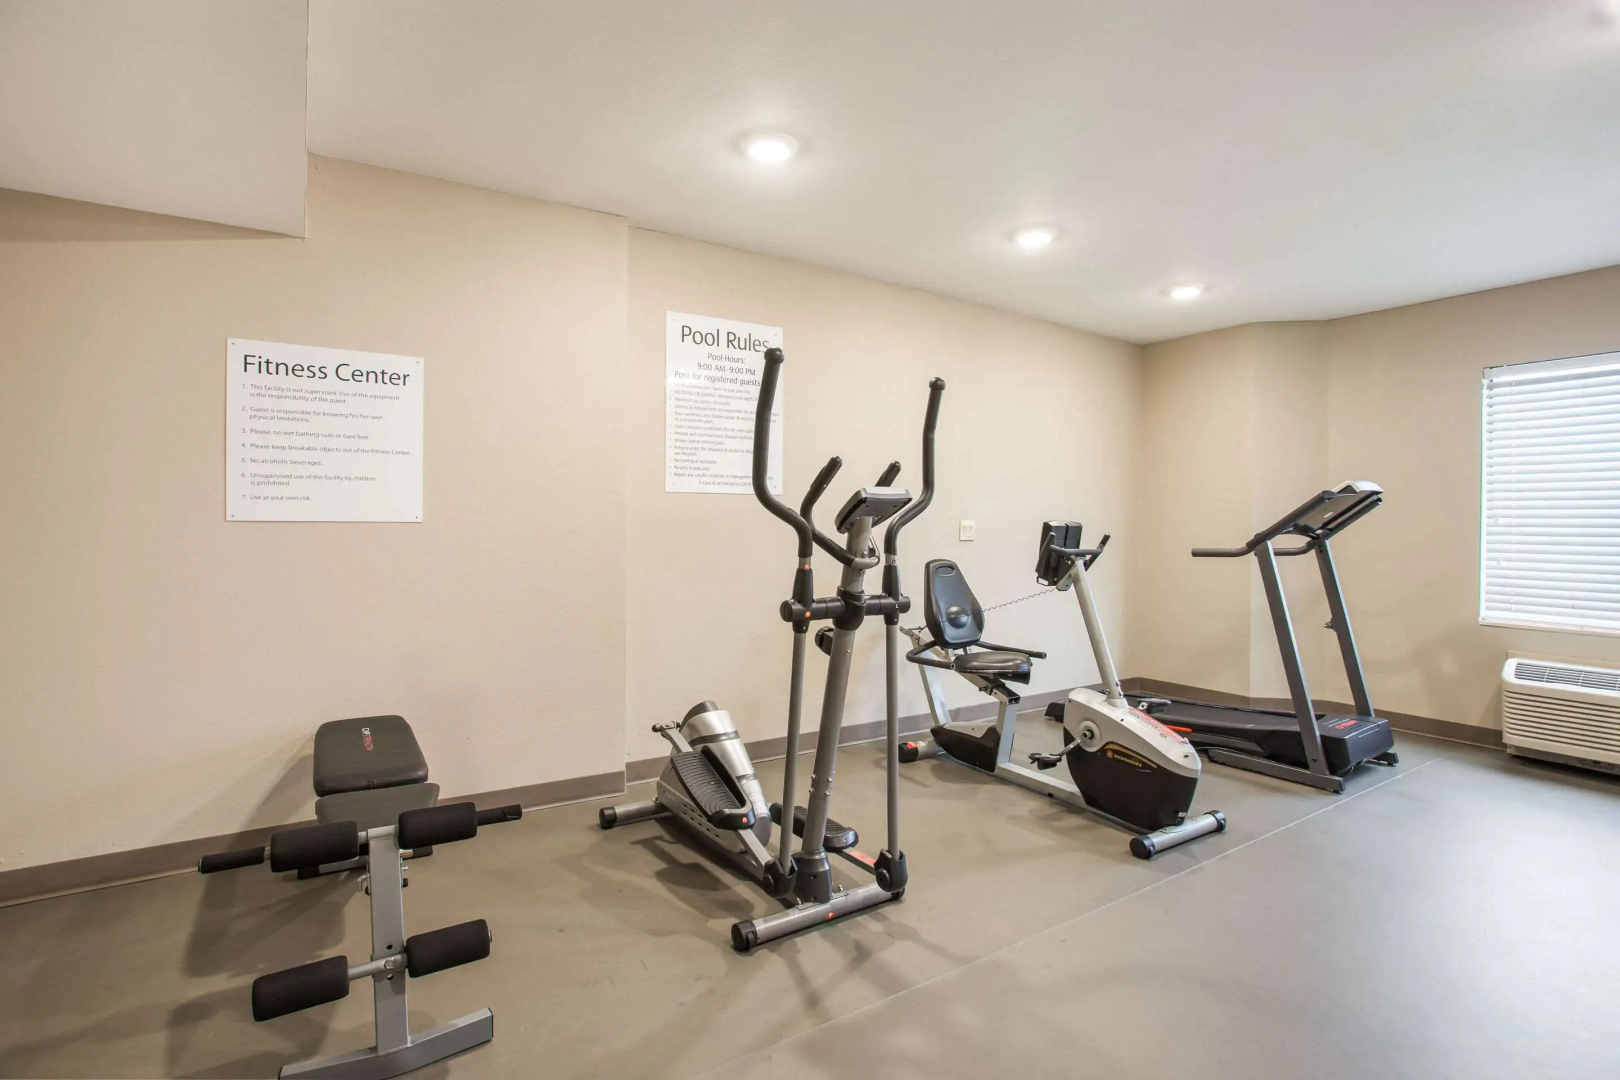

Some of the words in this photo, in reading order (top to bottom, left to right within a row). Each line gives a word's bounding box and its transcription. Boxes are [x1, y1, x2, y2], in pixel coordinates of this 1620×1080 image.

[681, 325, 719, 347] Pool
[726, 331, 769, 353] Rules
[708, 352, 722, 361] Pool
[725, 355, 745, 364] Hours:
[243, 354, 328, 380] Fitness
[335, 363, 410, 387] Center
[697, 362, 712, 371] 9:00
[746, 368, 755, 376] PM
[675, 370, 689, 379] Pool
[693, 372, 702, 380] for
[704, 373, 737, 386] registered
[740, 377, 760, 388] guests
[264, 385, 285, 393] facility
[369, 393, 400, 402] equipment
[268, 393, 309, 403] responsibility
[250, 413, 275, 422] physical
[277, 415, 310, 423] limitations.
[276, 408, 311, 417] responsible
[322, 411, 348, 419] knowing
[296, 431, 320, 439] bathing
[272, 444, 286, 452] keep
[319, 446, 341, 454] objects
[290, 459, 323, 467] beverages.
[250, 472, 293, 481] Unsupervised
